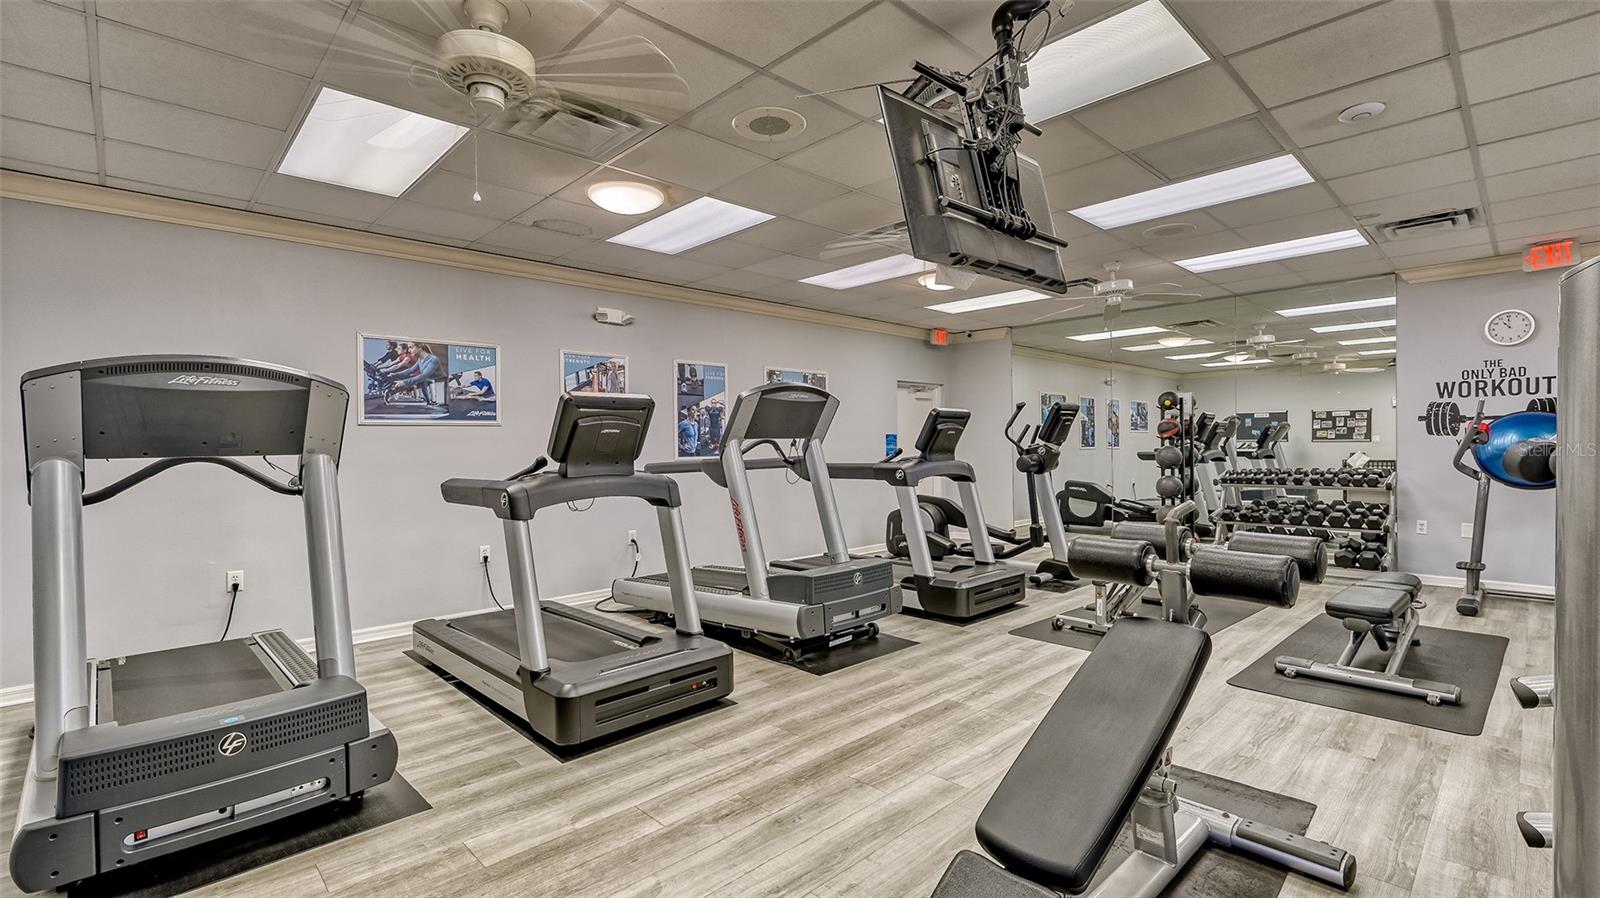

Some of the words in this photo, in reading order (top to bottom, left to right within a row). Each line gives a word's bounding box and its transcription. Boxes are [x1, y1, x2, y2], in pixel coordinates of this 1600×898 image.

[1531, 240, 1573, 269] EXIT
[455, 354, 491, 362] HEALTH
[1483, 359, 1503, 368] THE
[1461, 368, 1495, 380] ONLY
[1500, 367, 1527, 378] BAD
[1436, 376, 1556, 399] WORKOUT
